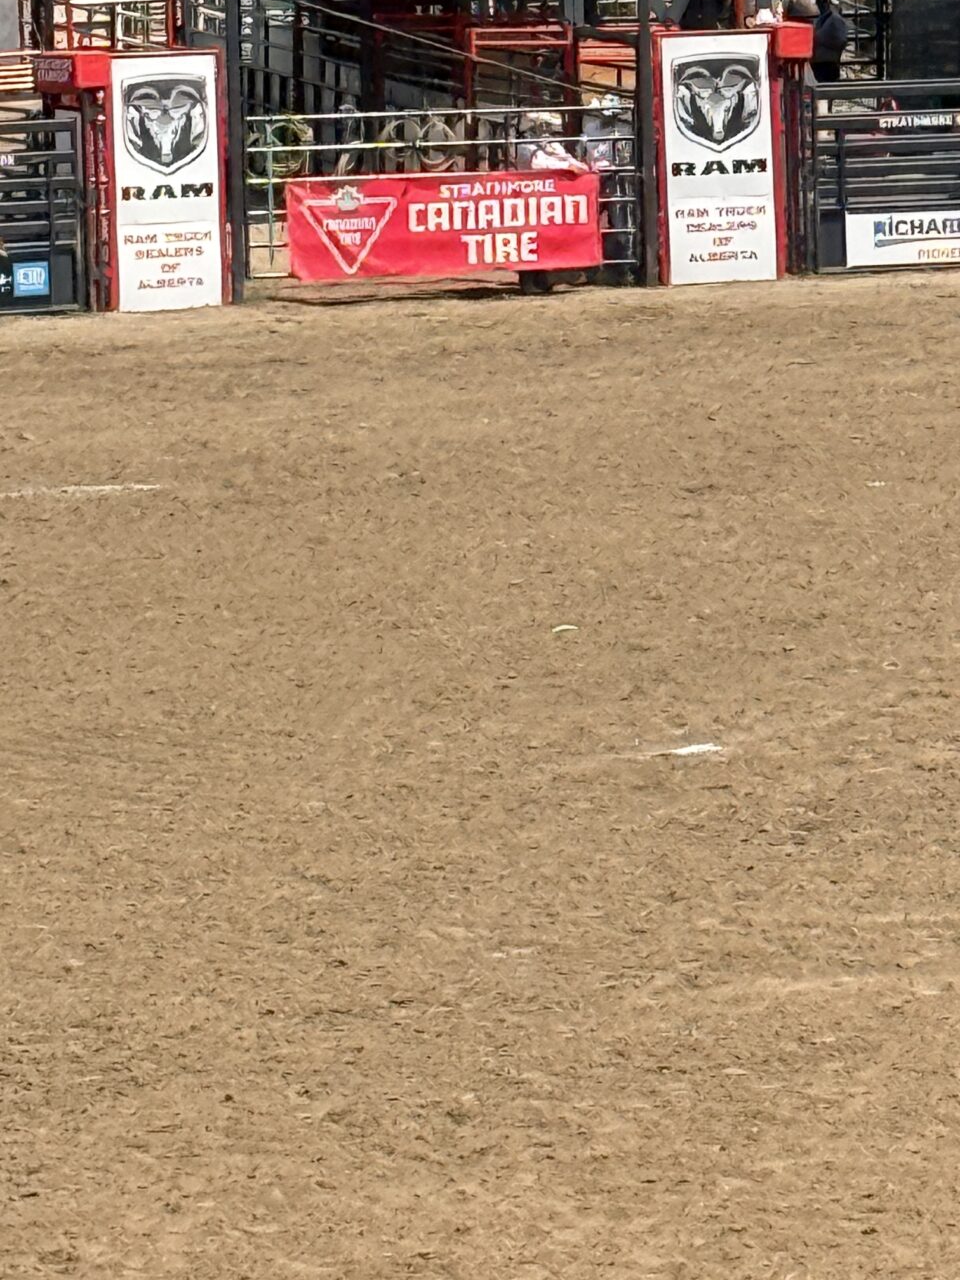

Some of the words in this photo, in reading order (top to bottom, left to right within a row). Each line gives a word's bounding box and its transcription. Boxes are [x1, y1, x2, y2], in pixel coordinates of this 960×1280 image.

[671, 158, 768, 177] RAM
[120, 182, 214, 202] RAM
[407, 194, 590, 233] CANADIAN
[460, 231, 539, 265] TIRE
